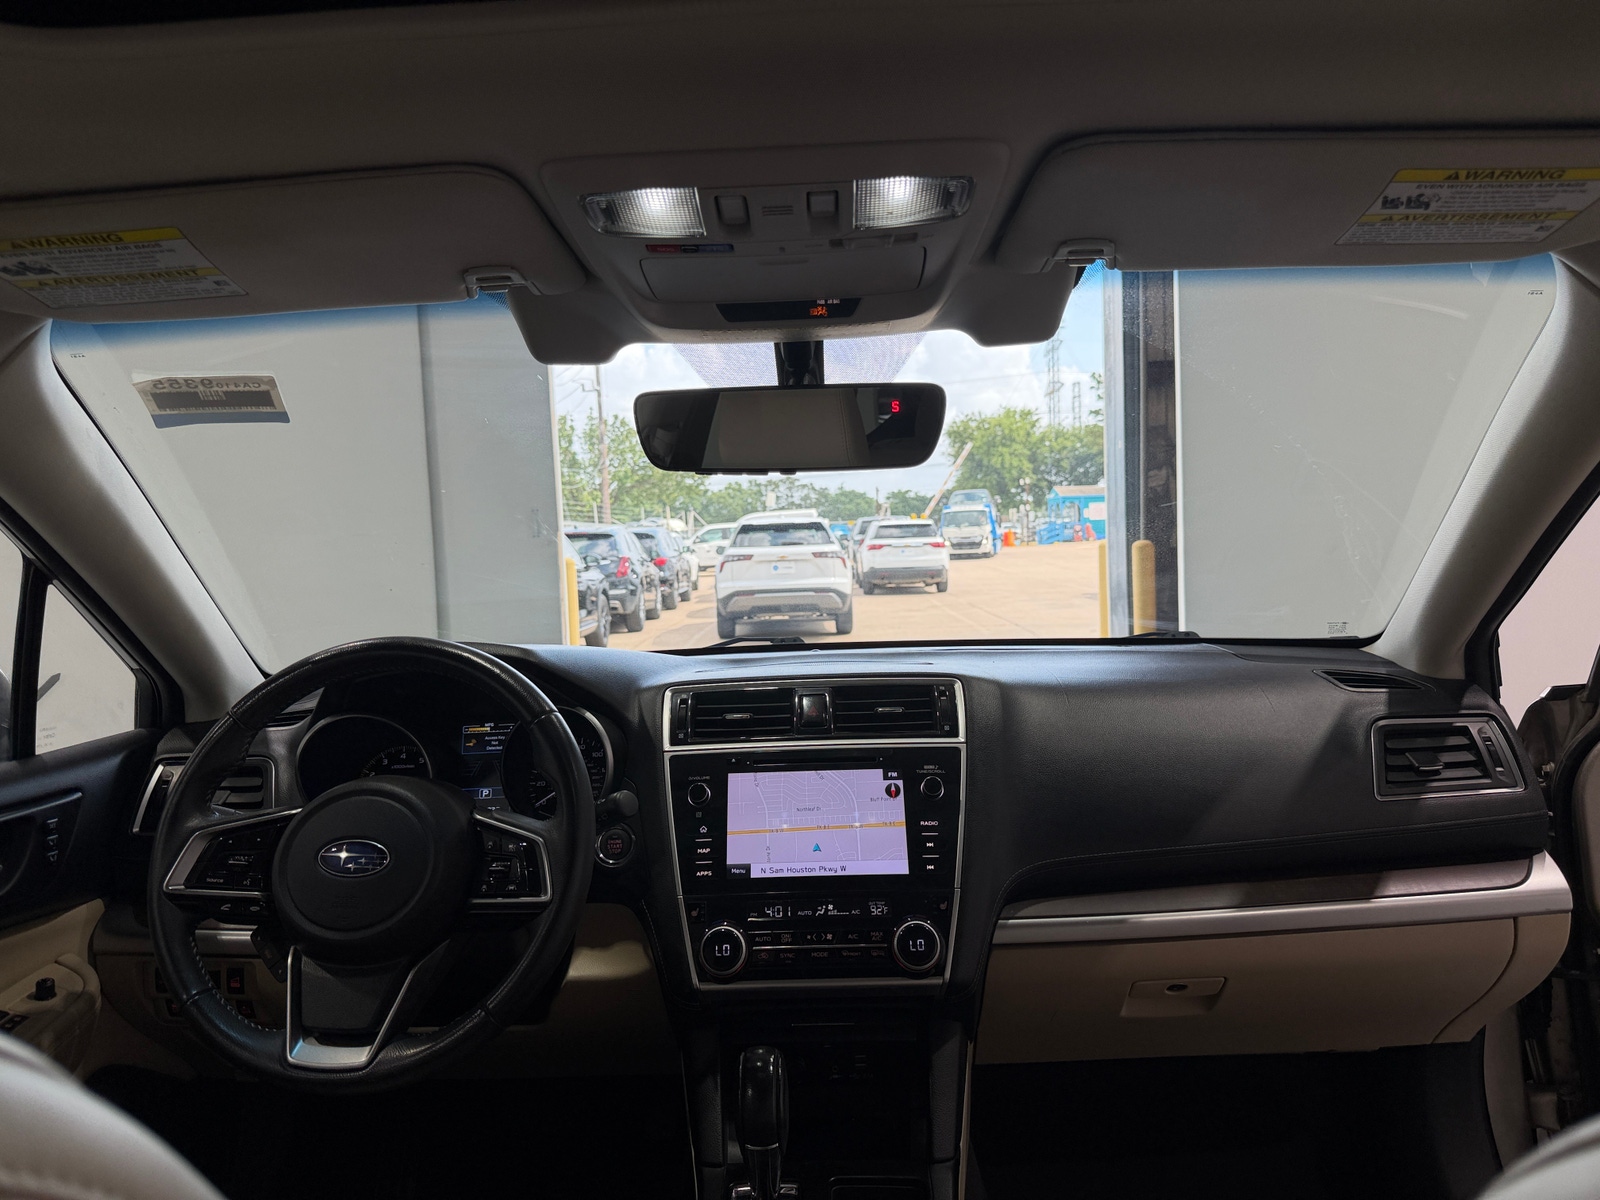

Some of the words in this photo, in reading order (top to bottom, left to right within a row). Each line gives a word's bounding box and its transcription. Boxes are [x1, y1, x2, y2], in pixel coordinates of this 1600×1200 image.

[1465, 170, 1566, 180] WARNING
[1398, 212, 1552, 221] AVERTISSEMENT
[22, 233, 124, 249] WARNING
[58, 246, 113, 254] ADVANCED
[115, 244, 132, 252] AIR
[54, 268, 198, 286] AVERTISSEMENT
[818, 865, 838, 873] Pkwy
[764, 905, 791, 918] 4:01
